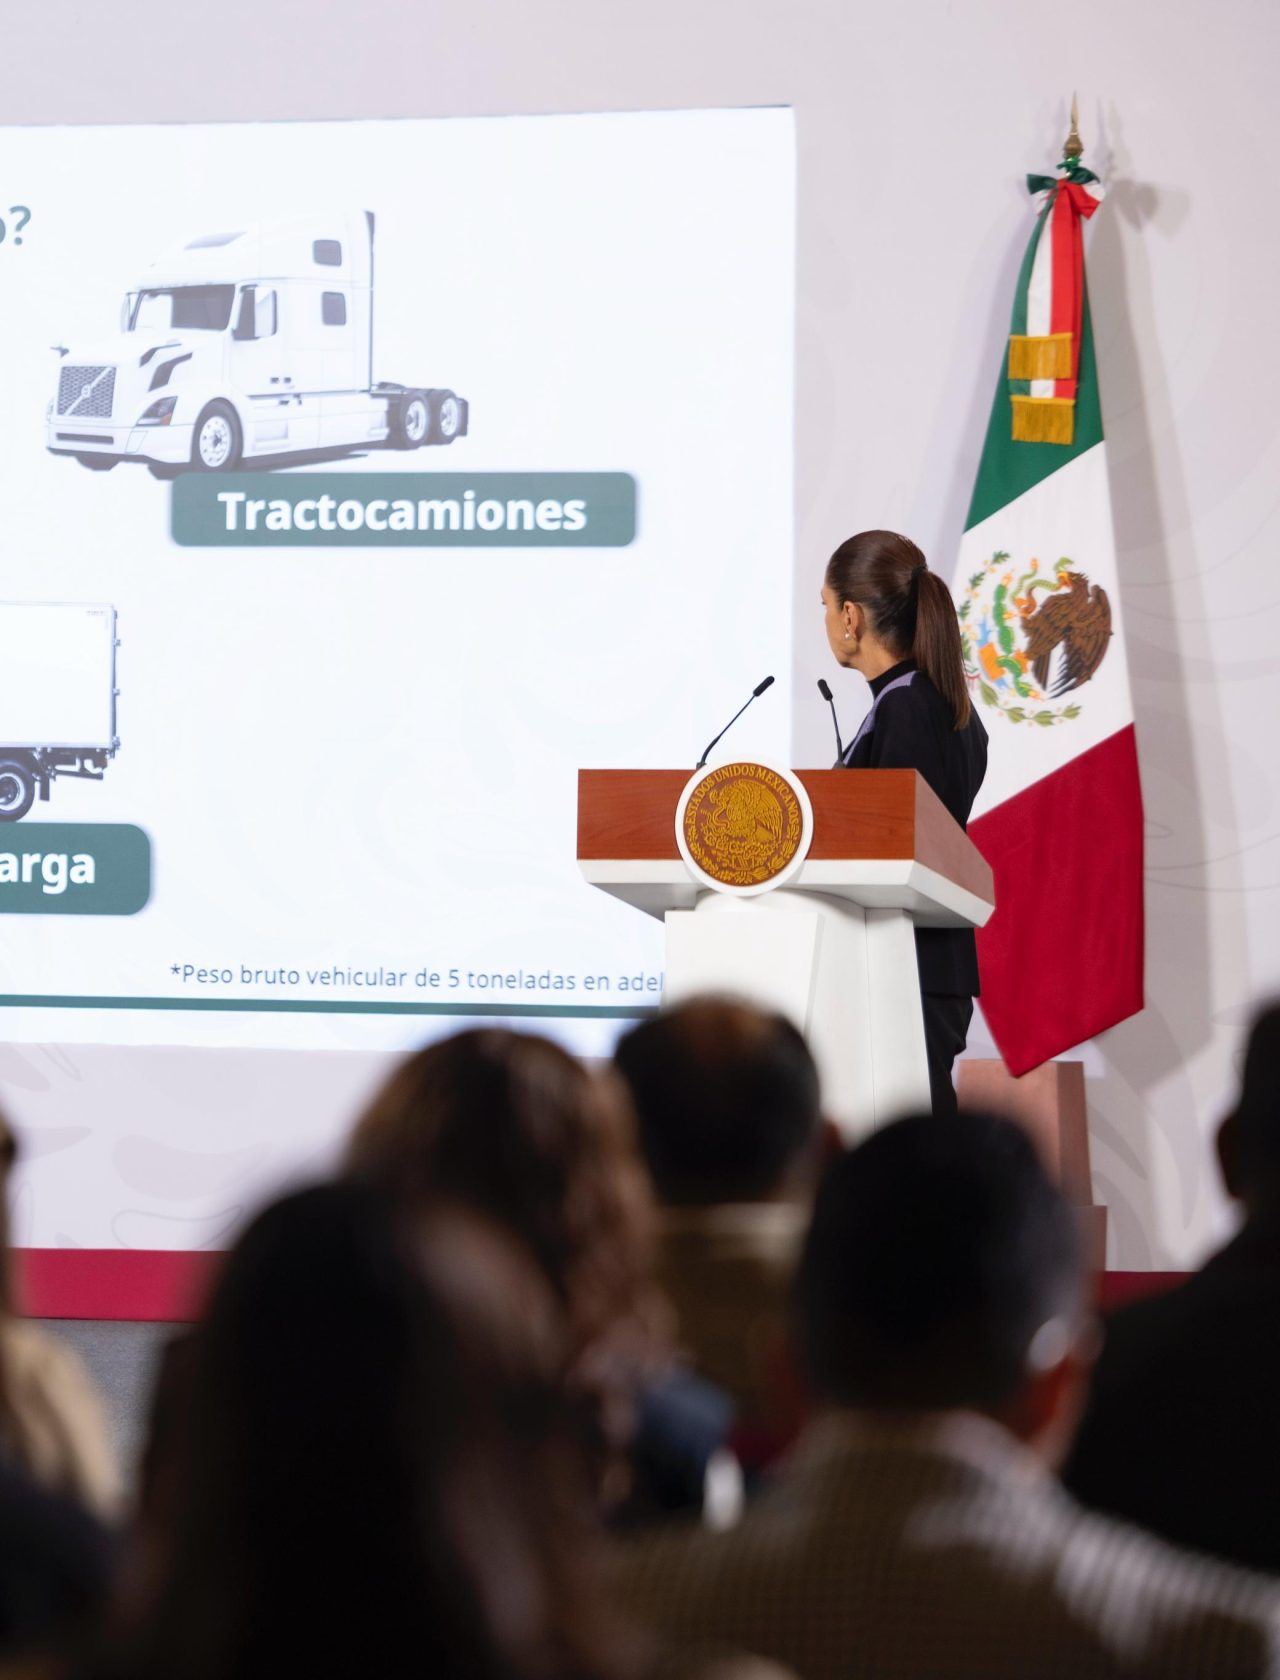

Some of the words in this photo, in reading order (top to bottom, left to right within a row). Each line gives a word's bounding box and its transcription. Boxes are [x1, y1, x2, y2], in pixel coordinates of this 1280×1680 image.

[217, 490, 587, 531] Tractocamiones
[685, 778, 715, 824] ESTADOS
[714, 764, 755, 782] UNIDOS
[756, 765, 800, 825] MEXICANOS
[240, 964, 300, 985] bruto
[306, 966, 408, 987] vehicular
[415, 967, 441, 988] de
[448, 968, 460, 988] 5
[467, 970, 576, 991] toneladas
[583, 975, 610, 991] en
